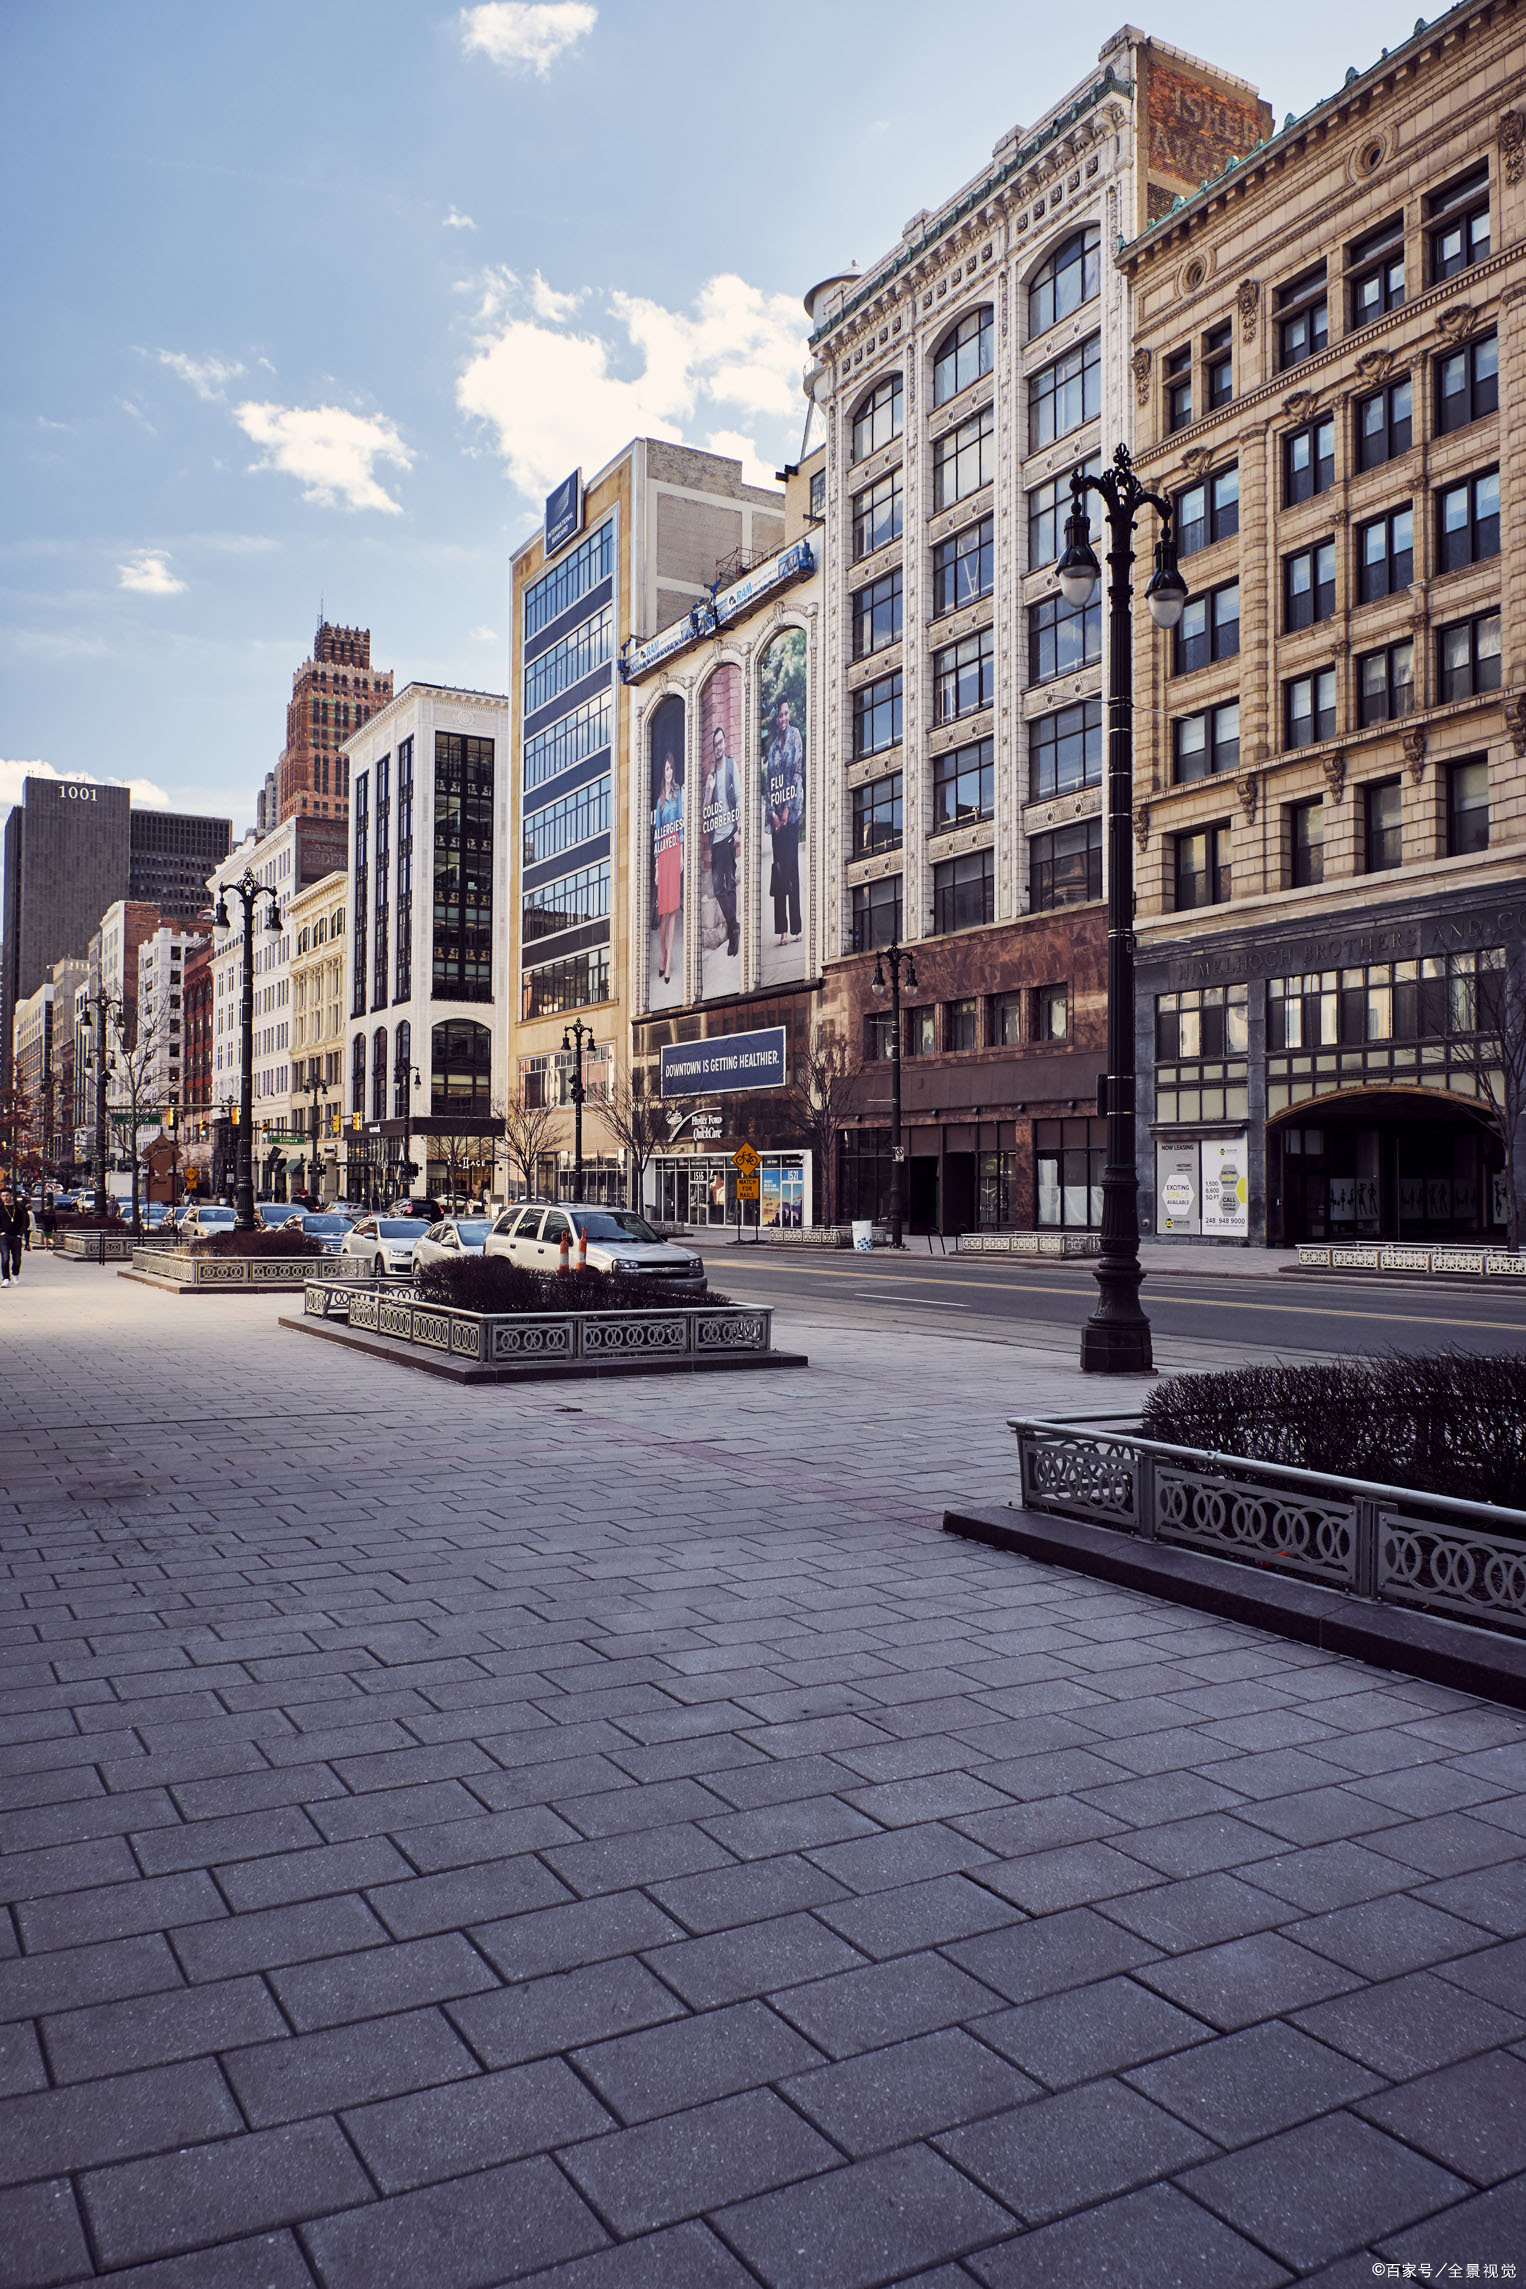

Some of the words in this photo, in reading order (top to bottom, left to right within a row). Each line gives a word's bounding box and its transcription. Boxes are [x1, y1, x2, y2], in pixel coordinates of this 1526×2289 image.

[736, 582, 753, 601] RAM
[646, 640, 660, 657] RAM
[770, 773, 784, 790] FLU
[58, 785, 98, 801] 1001
[770, 784, 798, 806] FOILED.
[703, 801, 723, 819] COLDS
[654, 818, 685, 842] ALLERGIES
[653, 835, 678, 855] ALLAYED.
[1304, 928, 1417, 961] BROTHERS
[1432, 918, 1483, 946] AND
[665, 1060, 702, 1078] DOWNTOWN
[702, 1059, 710, 1073] IS
[710, 1056, 738, 1072] GETTING
[739, 1050, 780, 1069] HEALTHIER.
[787, 1171, 799, 1180] 1521
